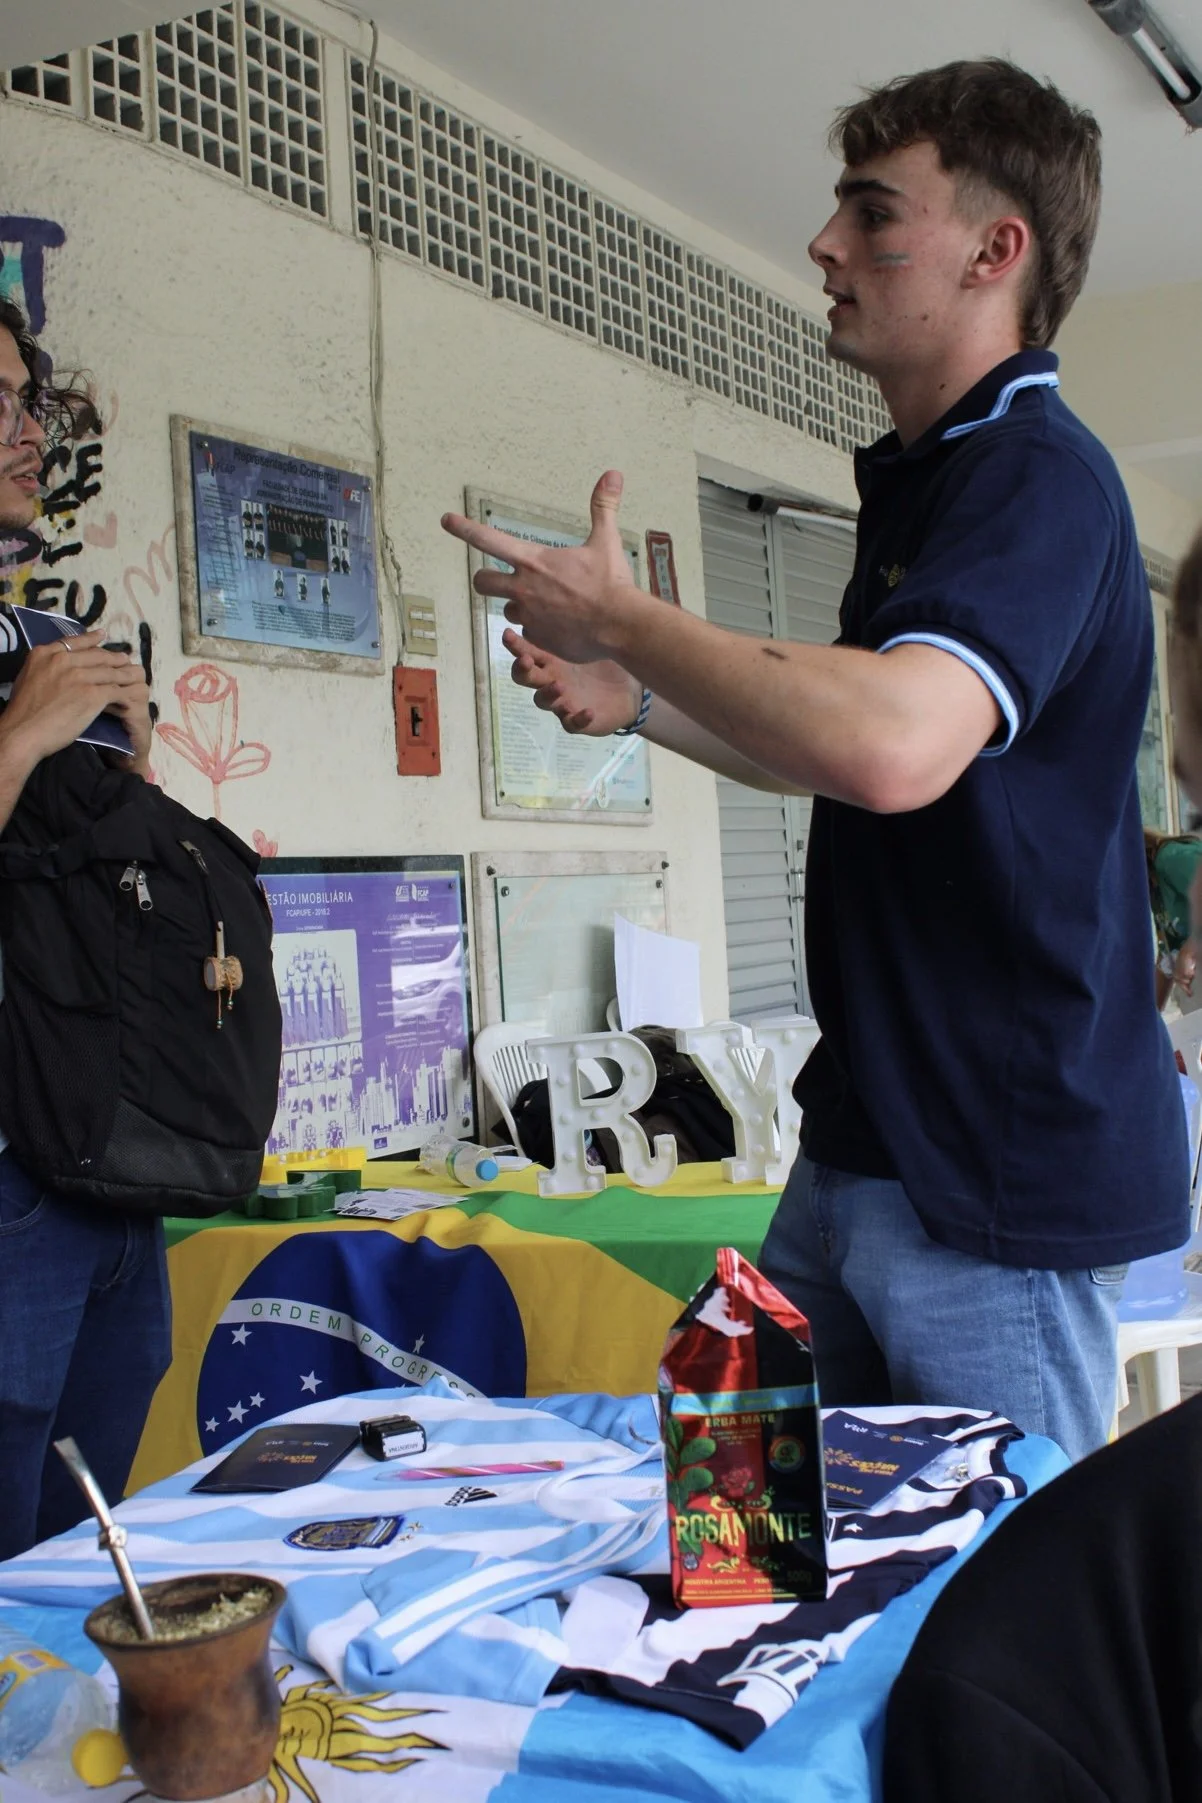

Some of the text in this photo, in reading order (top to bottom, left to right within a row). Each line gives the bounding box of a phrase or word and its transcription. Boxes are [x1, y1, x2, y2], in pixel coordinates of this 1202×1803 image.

[299, 463, 340, 484] Comercial
[267, 889, 354, 906] ESTÃO IMOBILIÁRIA
[251, 1303, 342, 1331] ORDEM
[741, 1413, 776, 1425] MATE
[675, 1513, 812, 1547] ROSAMONTE
